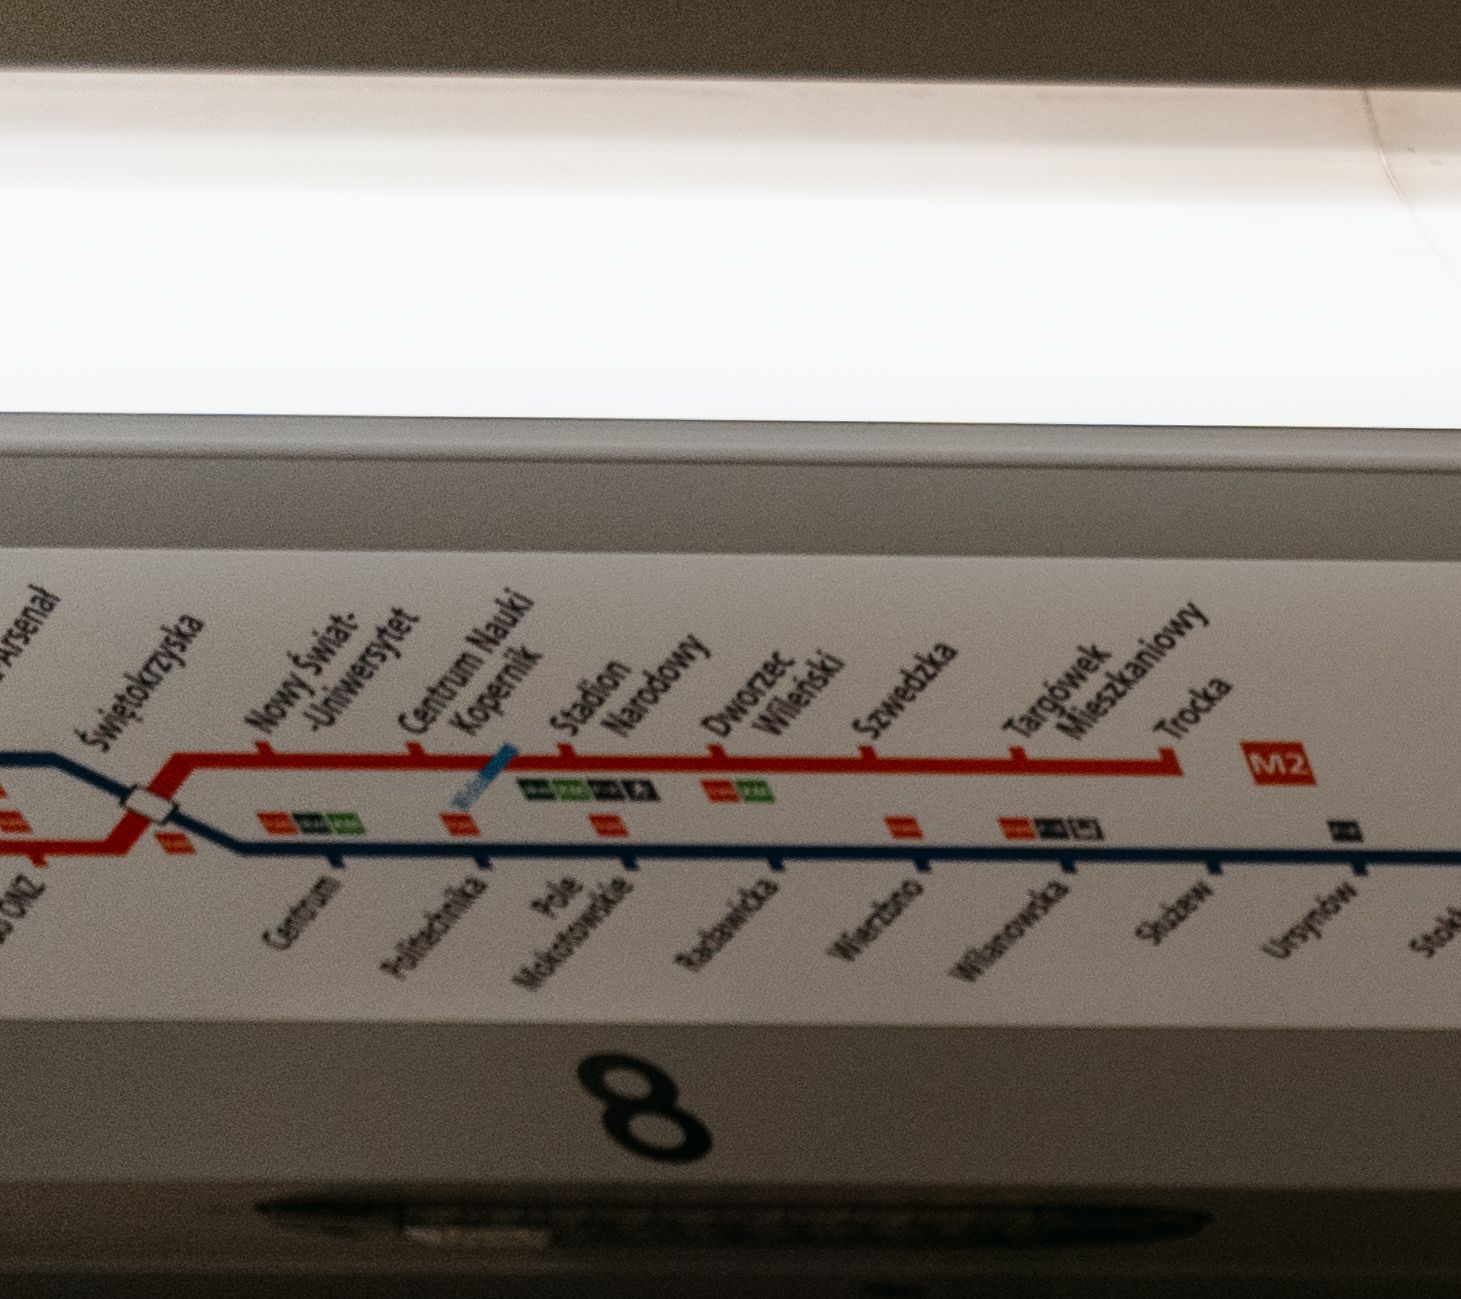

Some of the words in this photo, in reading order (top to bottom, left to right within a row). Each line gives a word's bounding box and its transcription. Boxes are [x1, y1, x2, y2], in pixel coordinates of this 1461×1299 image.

[74, 613, 206, 752] Świętokrzyska
[244, 670, 316, 735] Nowy
[303, 606, 420, 731] -Uniwersytet
[398, 652, 485, 735] Centrum
[465, 586, 534, 654] Nauki
[450, 643, 544, 736] Kopernik
[550, 659, 632, 737] Stadion
[601, 634, 712, 738] Narodowy
[701, 651, 796, 738] Dworzec
[752, 648, 845, 736] Wileński
[852, 641, 959, 740] Szwedzka
[1002, 641, 1112, 739] Targówek
[1055, 601, 1210, 742] Mieszkaniowy
[1153, 676, 1233, 740] Trocka
[1249, 751, 1311, 777] M2
[262, 875, 343, 951] Centrum
[380, 875, 488, 981] Politechnika
[510, 876, 634, 992] Mokotowskie
[530, 876, 584, 919] Pole
[826, 879, 924, 963] Wierzbno
[947, 879, 1070, 983] Wilanowska
[1260, 880, 1359, 960] Ursynów
[576, 1053, 714, 1165] 8
